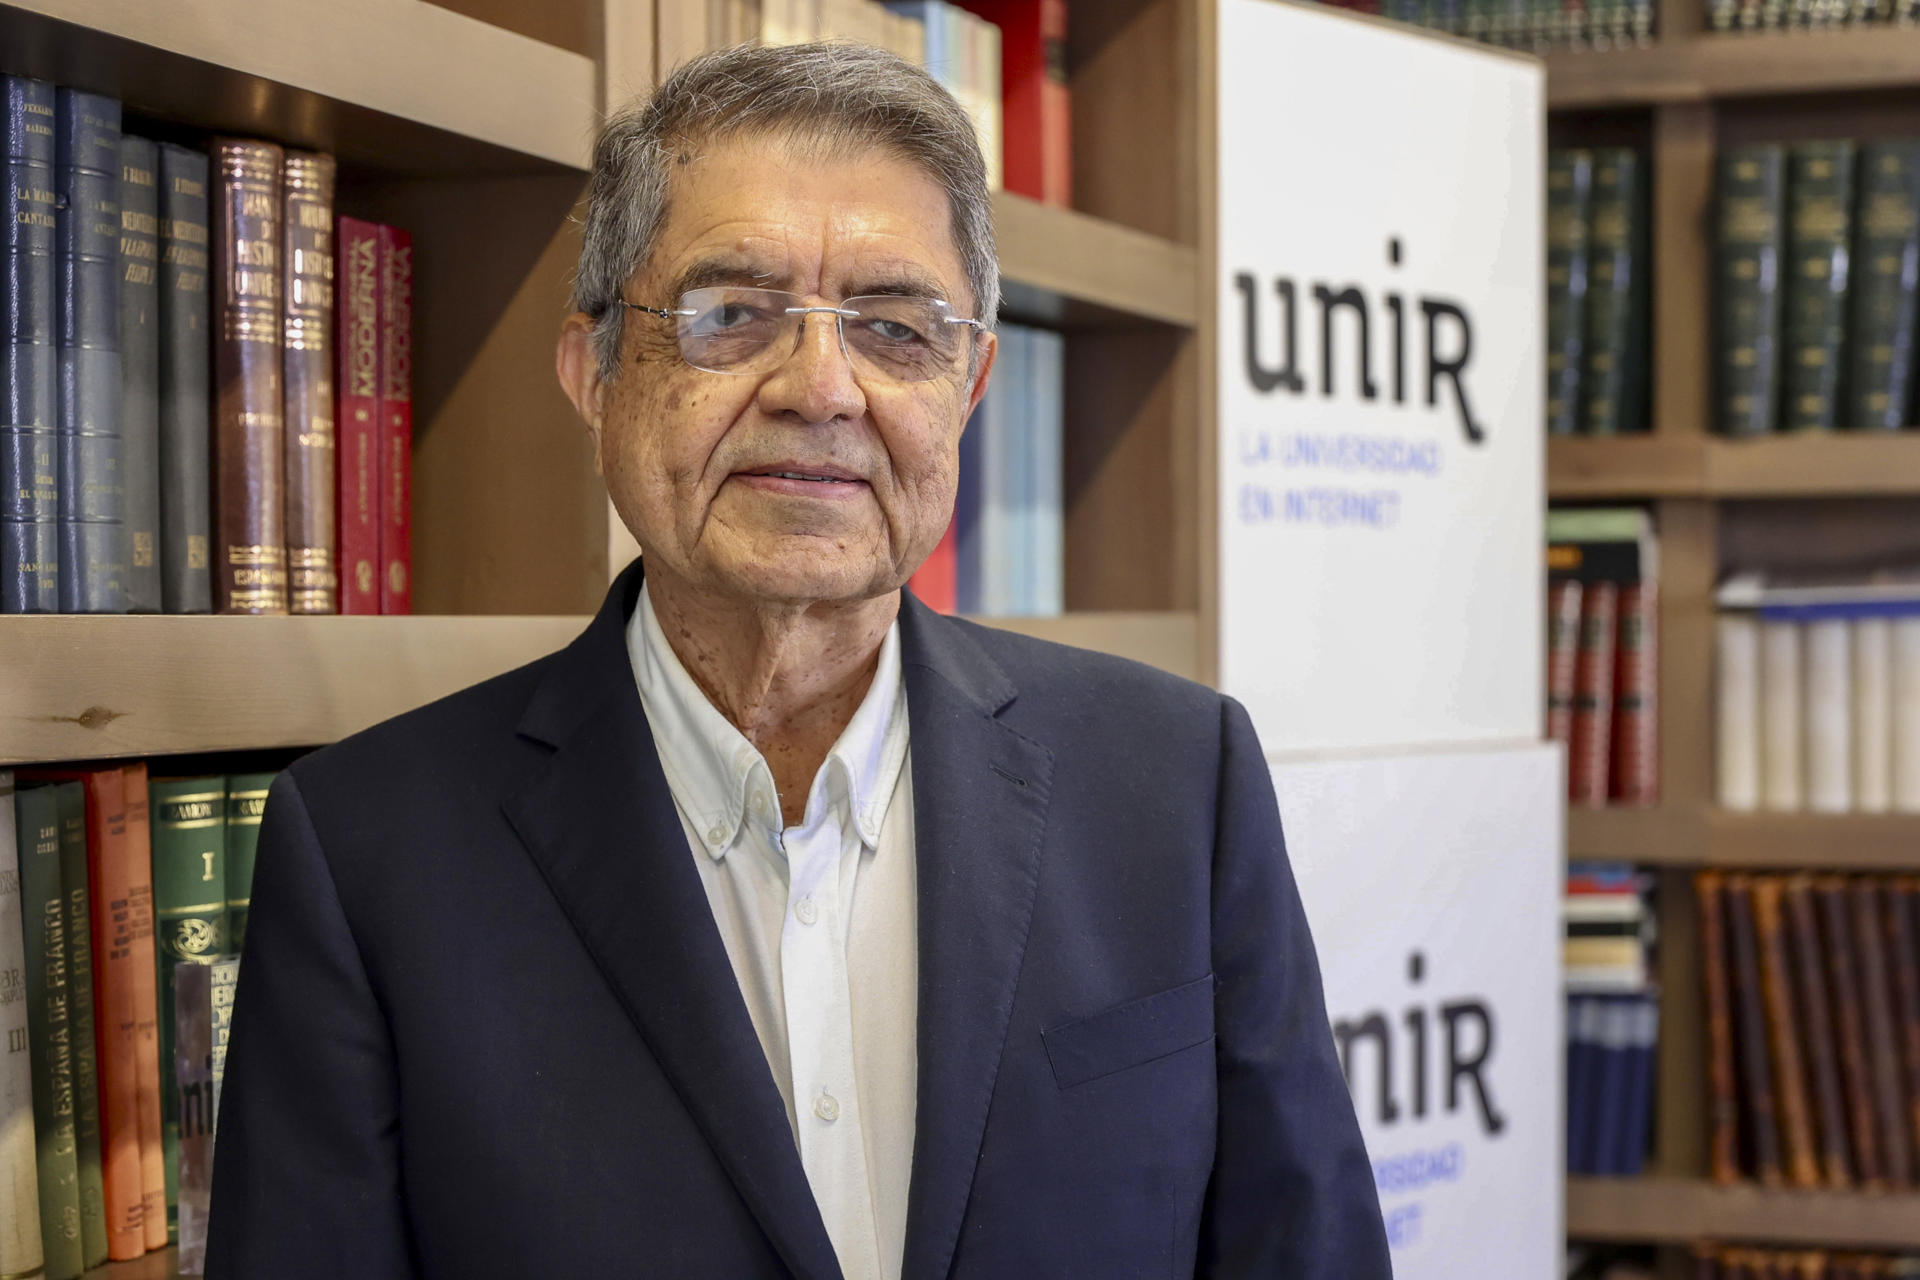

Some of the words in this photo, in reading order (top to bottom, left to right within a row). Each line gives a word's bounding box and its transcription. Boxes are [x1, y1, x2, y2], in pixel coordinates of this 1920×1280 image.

[358, 237, 377, 397] MODERNA
[201, 851, 215, 882] I
[44, 898, 67, 989] FRANCO
